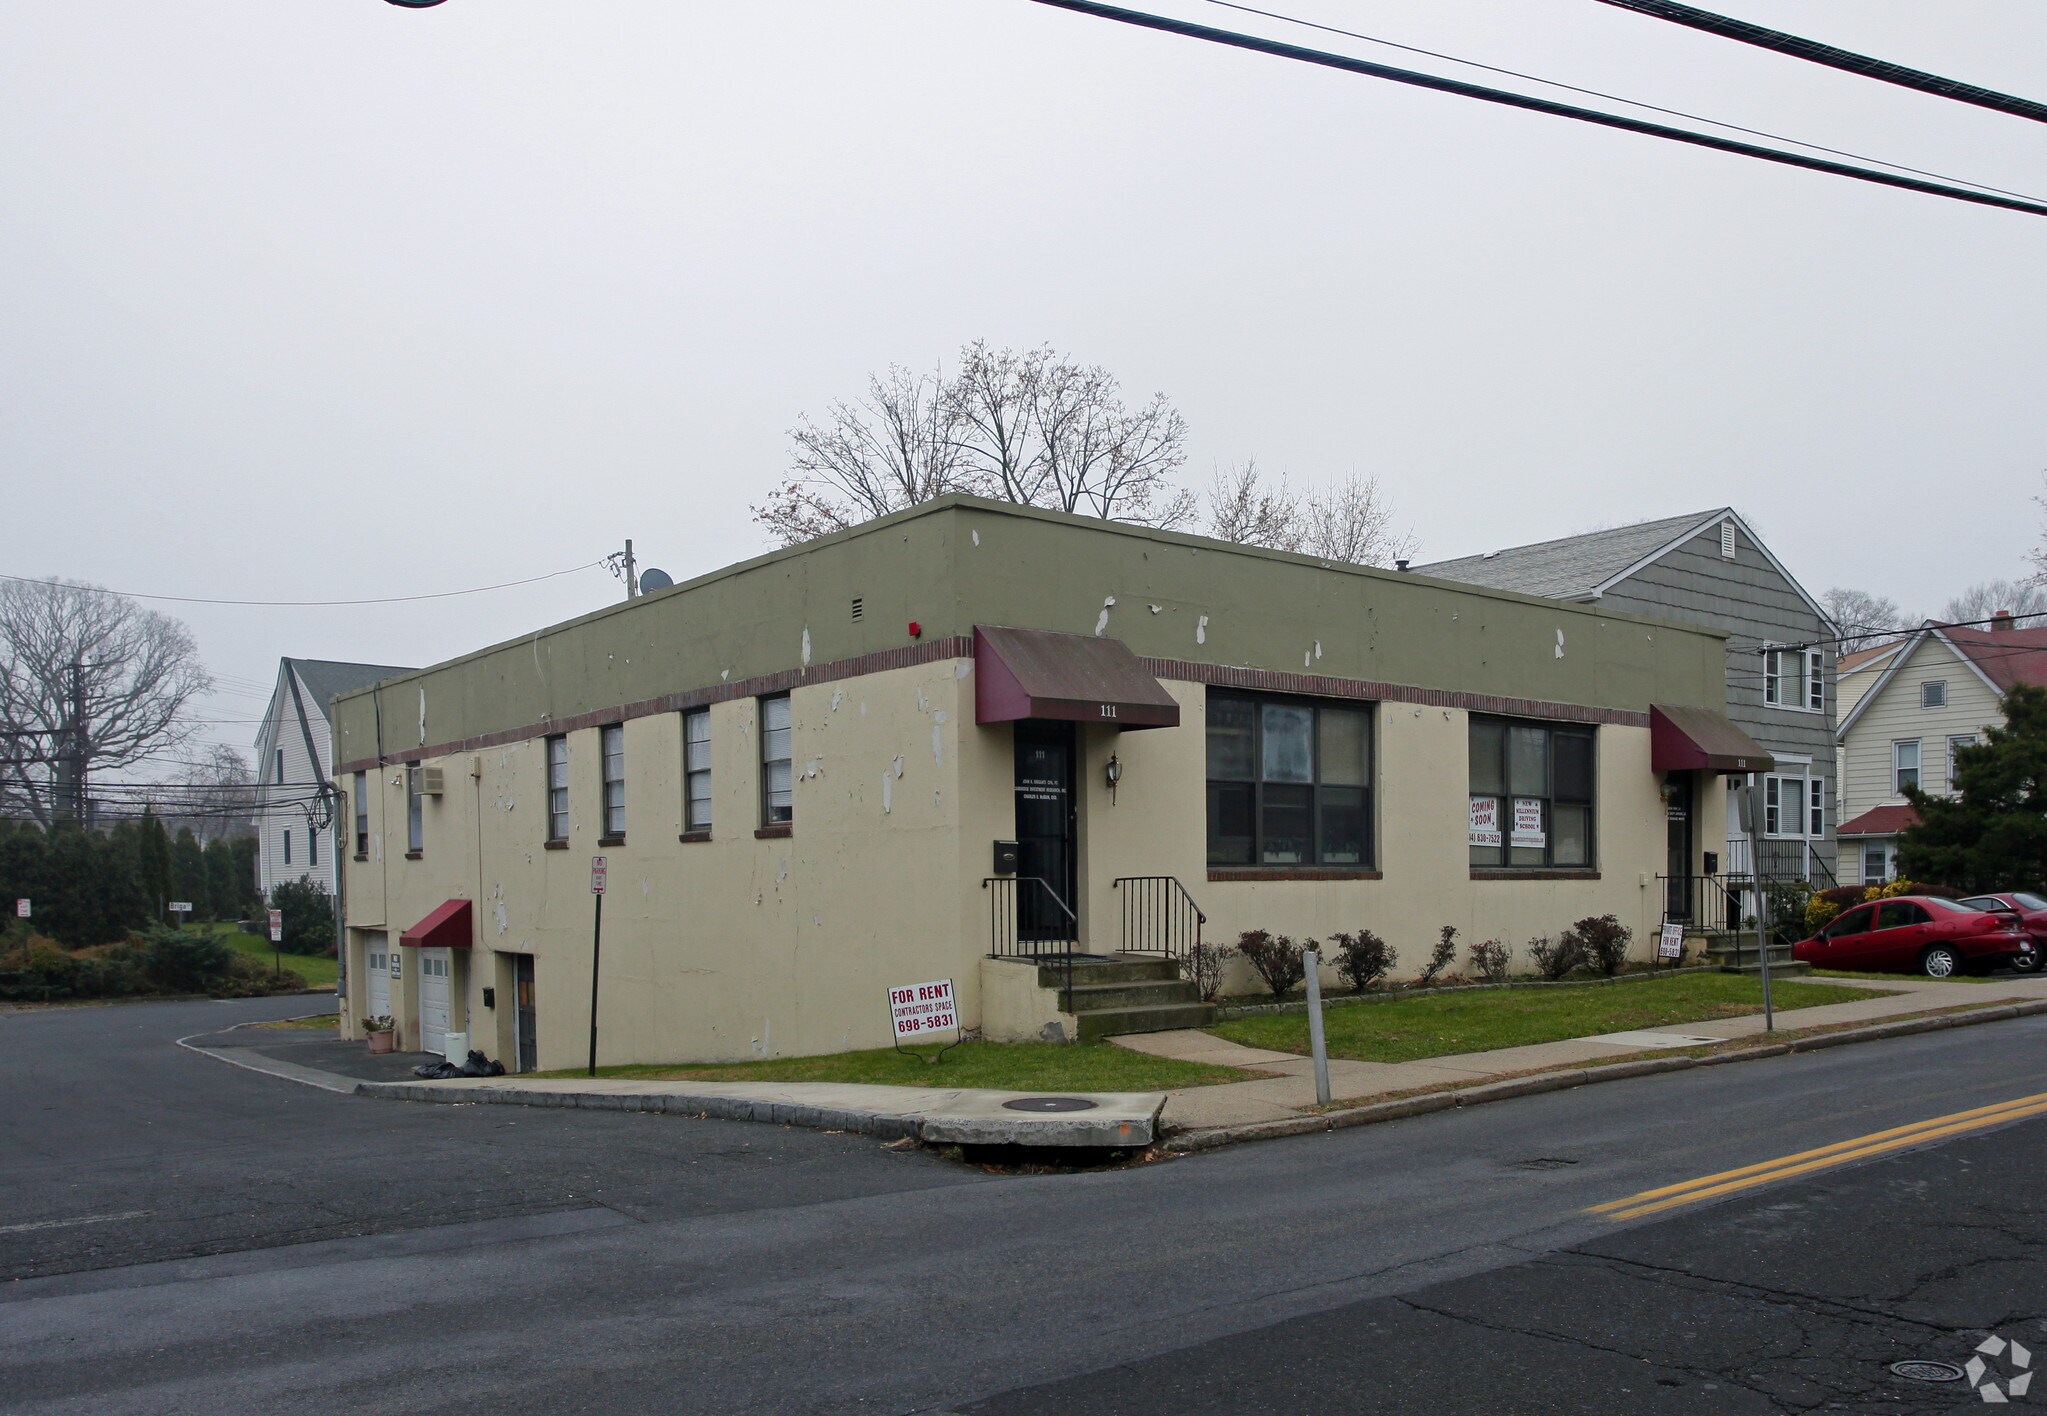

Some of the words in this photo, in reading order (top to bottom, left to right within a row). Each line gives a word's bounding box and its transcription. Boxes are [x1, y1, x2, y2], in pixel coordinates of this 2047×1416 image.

[1100, 704, 1117, 718] 111
[1035, 750, 1045, 759] 111
[1738, 758, 1746, 767] 111
[1471, 800, 1495, 813] COMING
[1475, 812, 1492, 826] SOON
[891, 989, 914, 1005] FOR
[919, 984, 949, 1000] RENT
[894, 1003, 933, 1017] CONTRACTORS
[935, 1001, 953, 1012] SPACE
[898, 1013, 953, 1032] 698-5831
